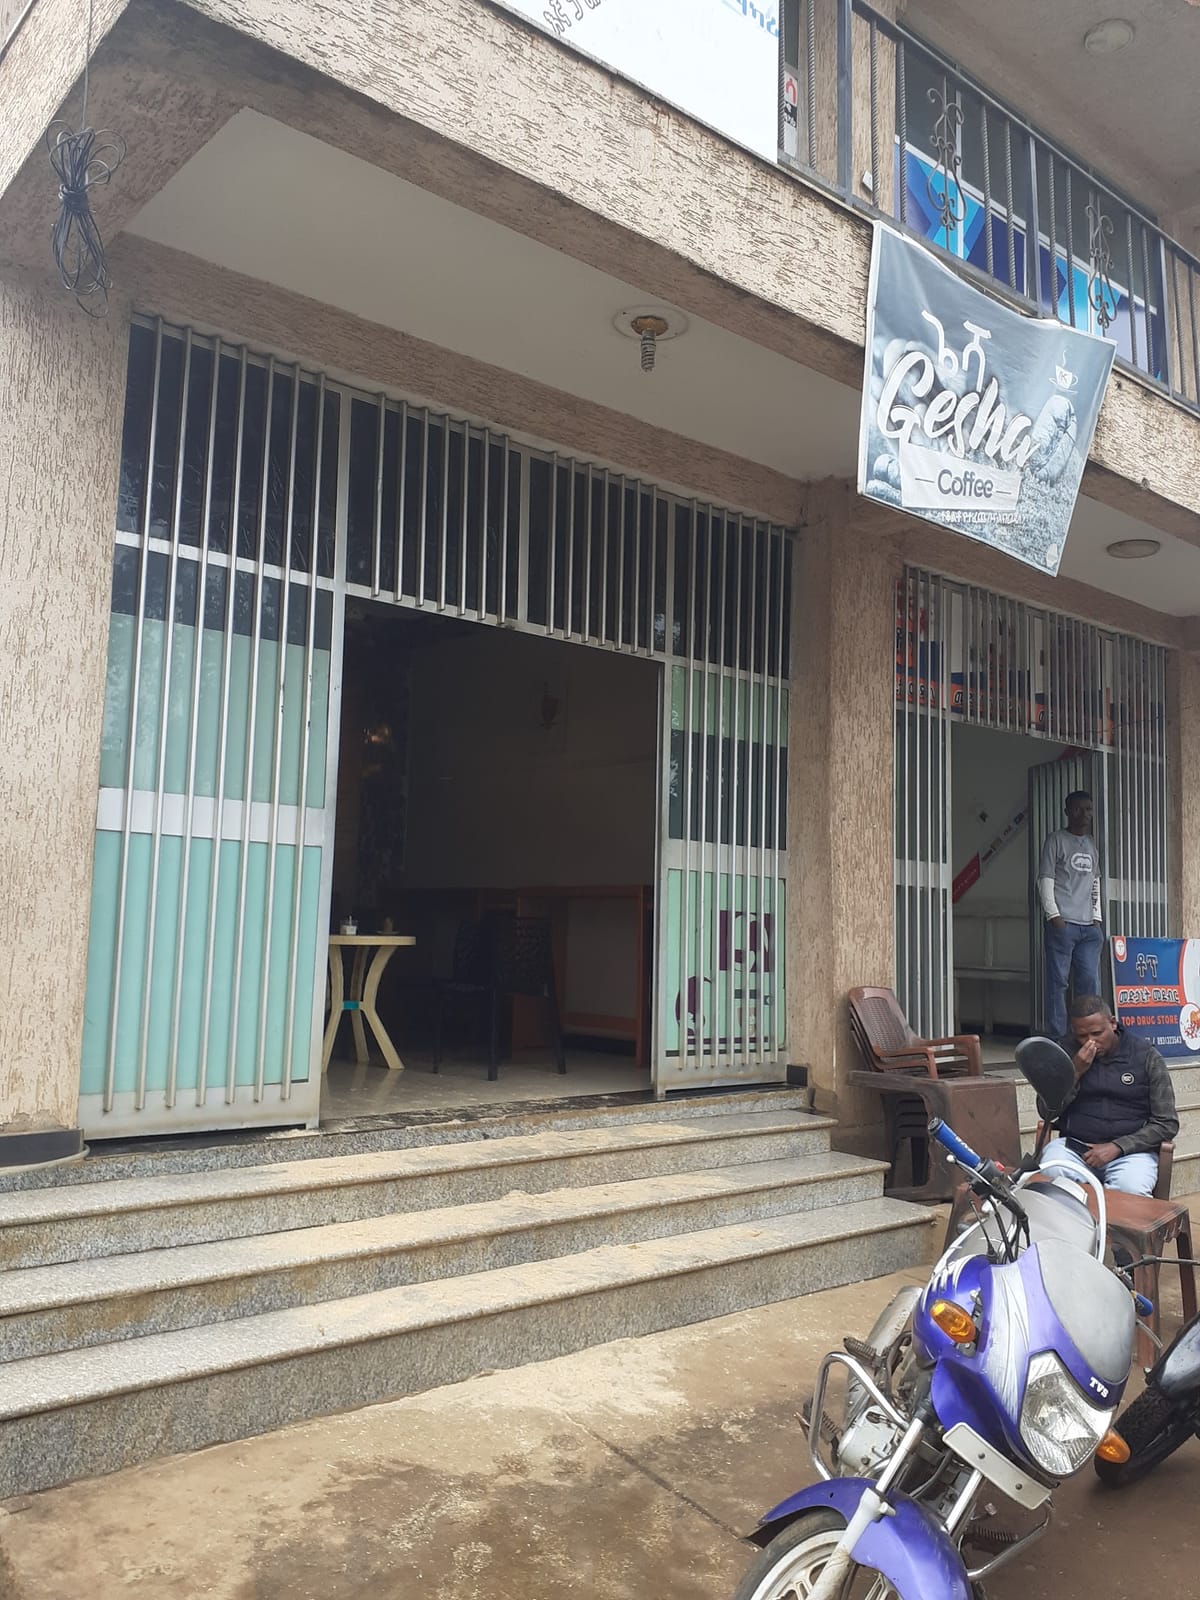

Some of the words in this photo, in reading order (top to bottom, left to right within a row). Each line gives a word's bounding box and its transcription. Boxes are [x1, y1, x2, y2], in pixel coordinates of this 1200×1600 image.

[921, 309, 992, 392] ጌሻ
[877, 351, 1040, 467] Gesha
[937, 468, 994, 498] Coffee
[1121, 1016, 1134, 1026] TOP
[1137, 1016, 1155, 1025] DRUG
[1157, 1015, 1178, 1025] STORE
[1089, 1376, 1109, 1398] TVS
